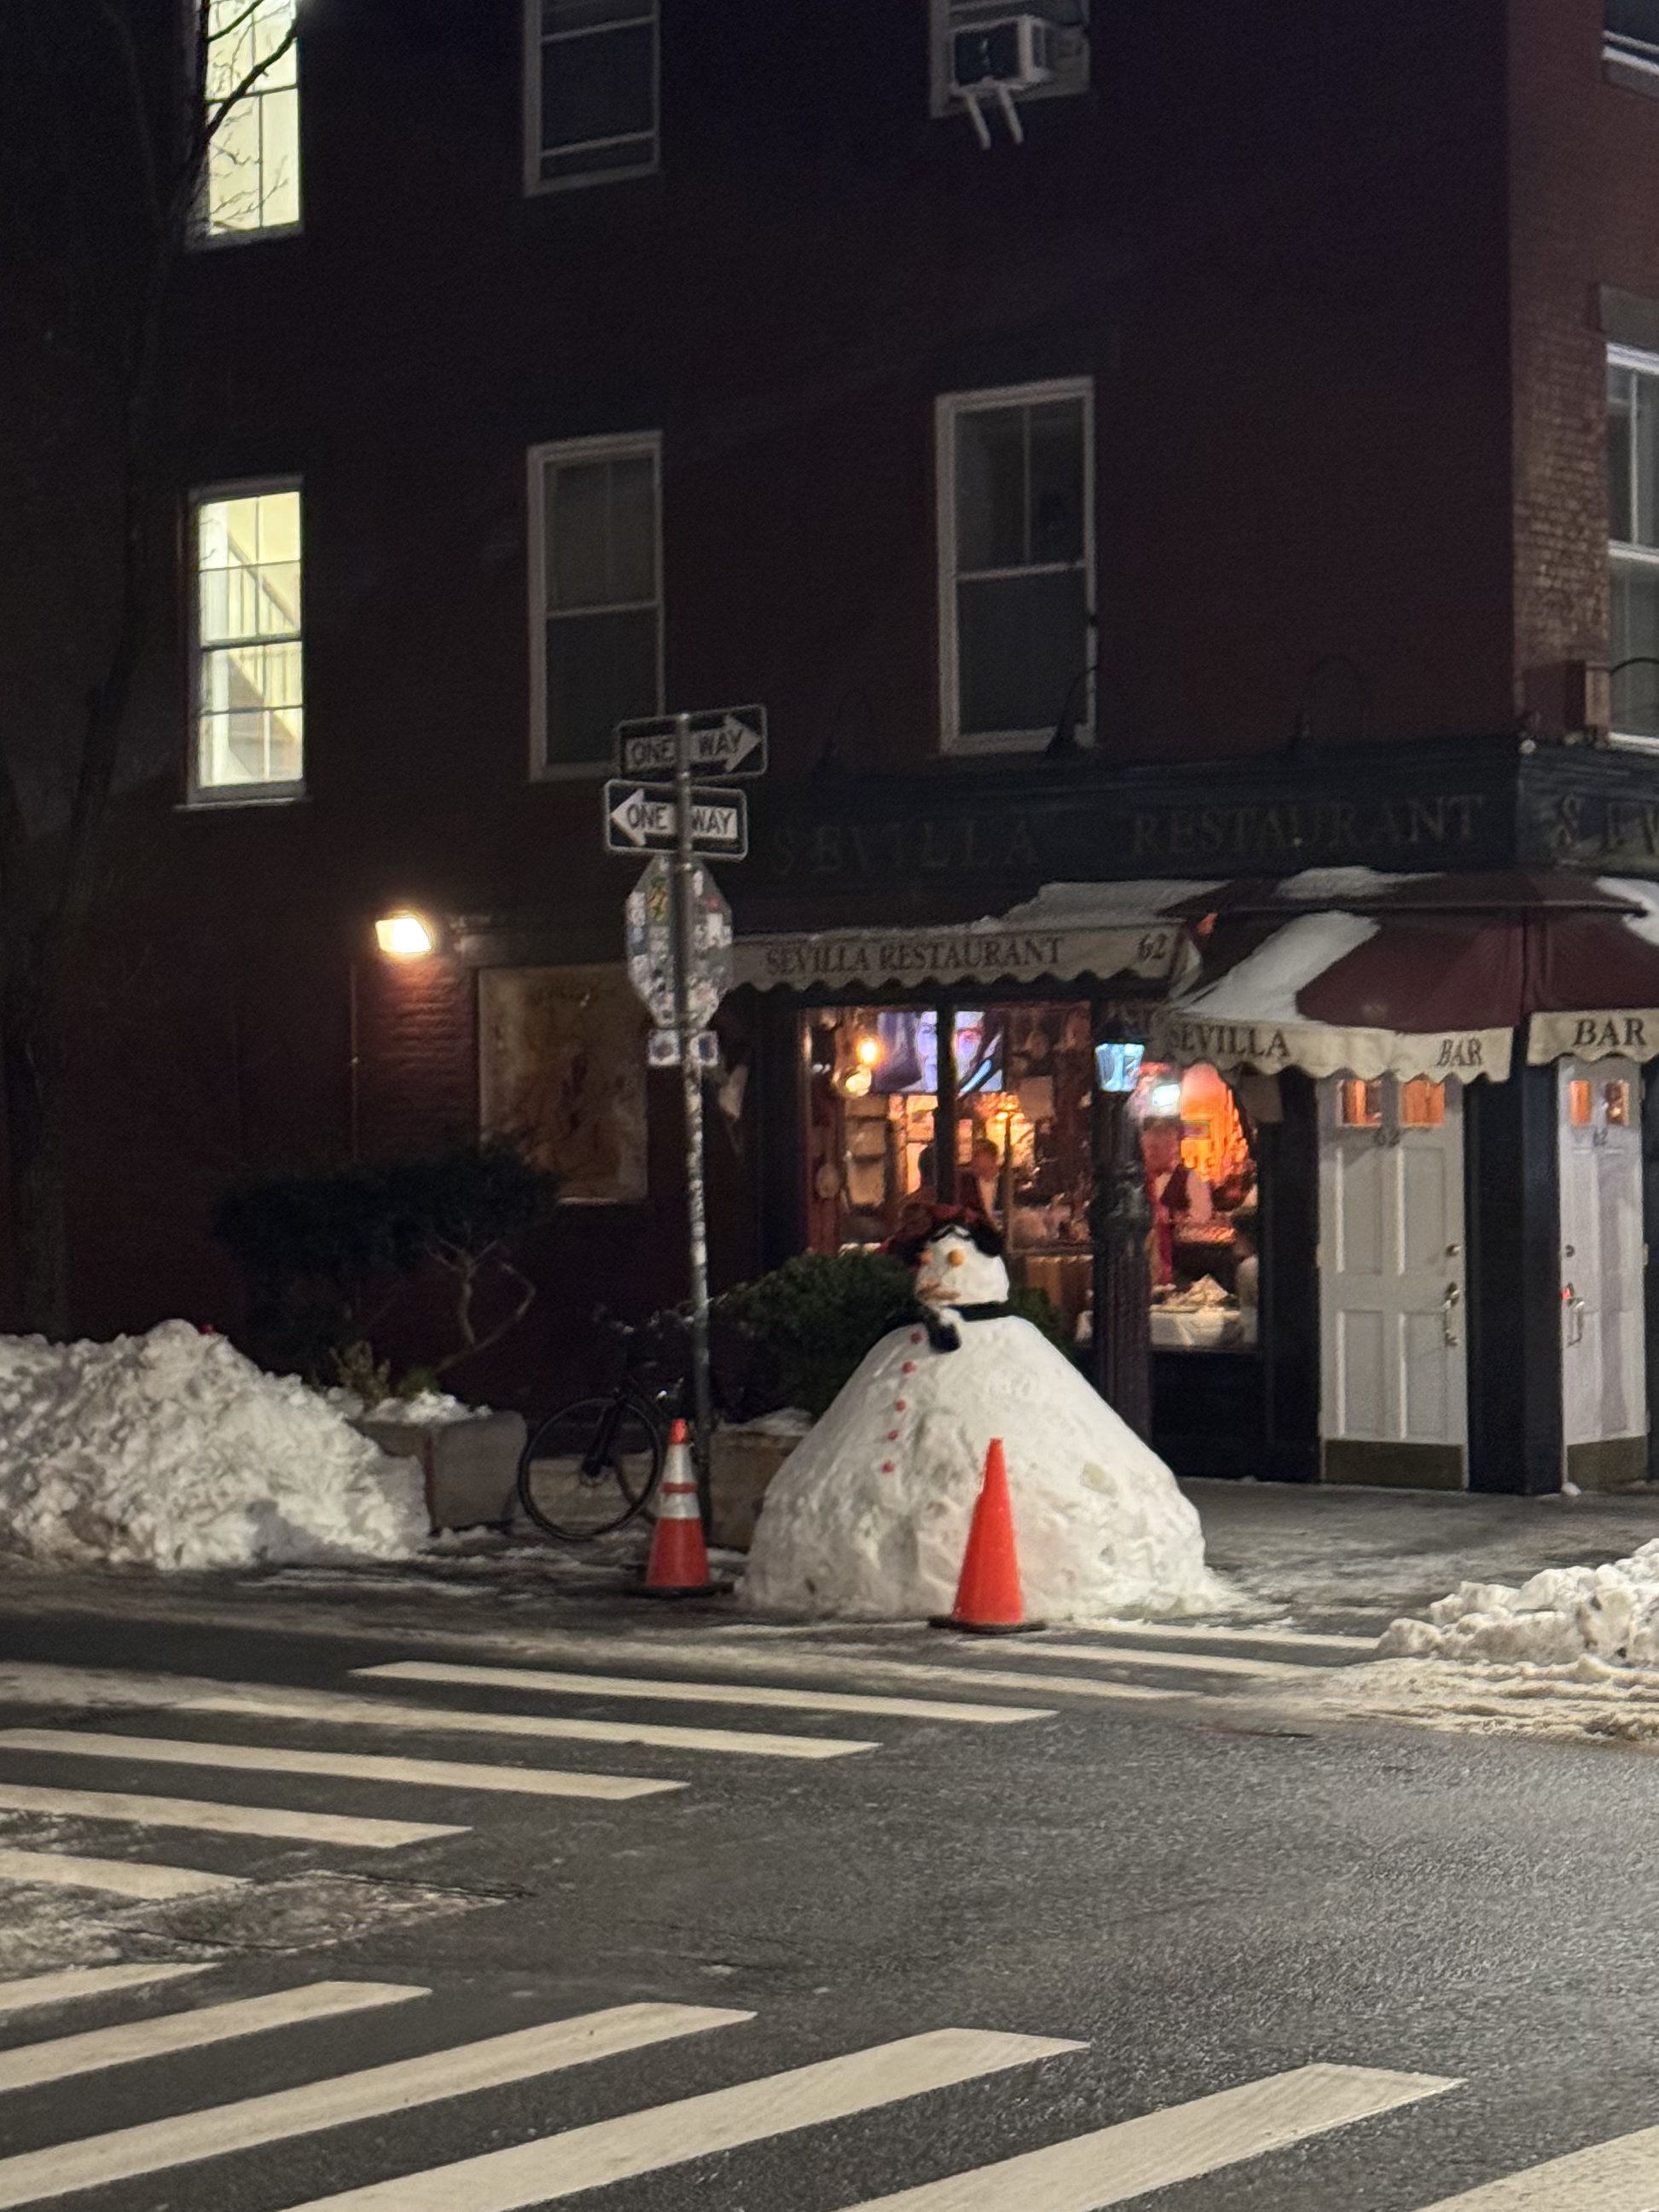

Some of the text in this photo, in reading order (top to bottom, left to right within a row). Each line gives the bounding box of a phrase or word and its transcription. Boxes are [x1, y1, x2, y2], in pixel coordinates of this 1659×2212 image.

[631, 728, 743, 765] ONE WAY
[626, 803, 733, 834] ONE WAY
[769, 794, 1484, 876] SEVILLA RESTAURANT
[767, 936, 1060, 976] SEVILLA RESTAURANT
[1137, 934, 1166, 961] 62
[1573, 1017, 1646, 1046] BAR
[1436, 1039, 1482, 1068] BAR
